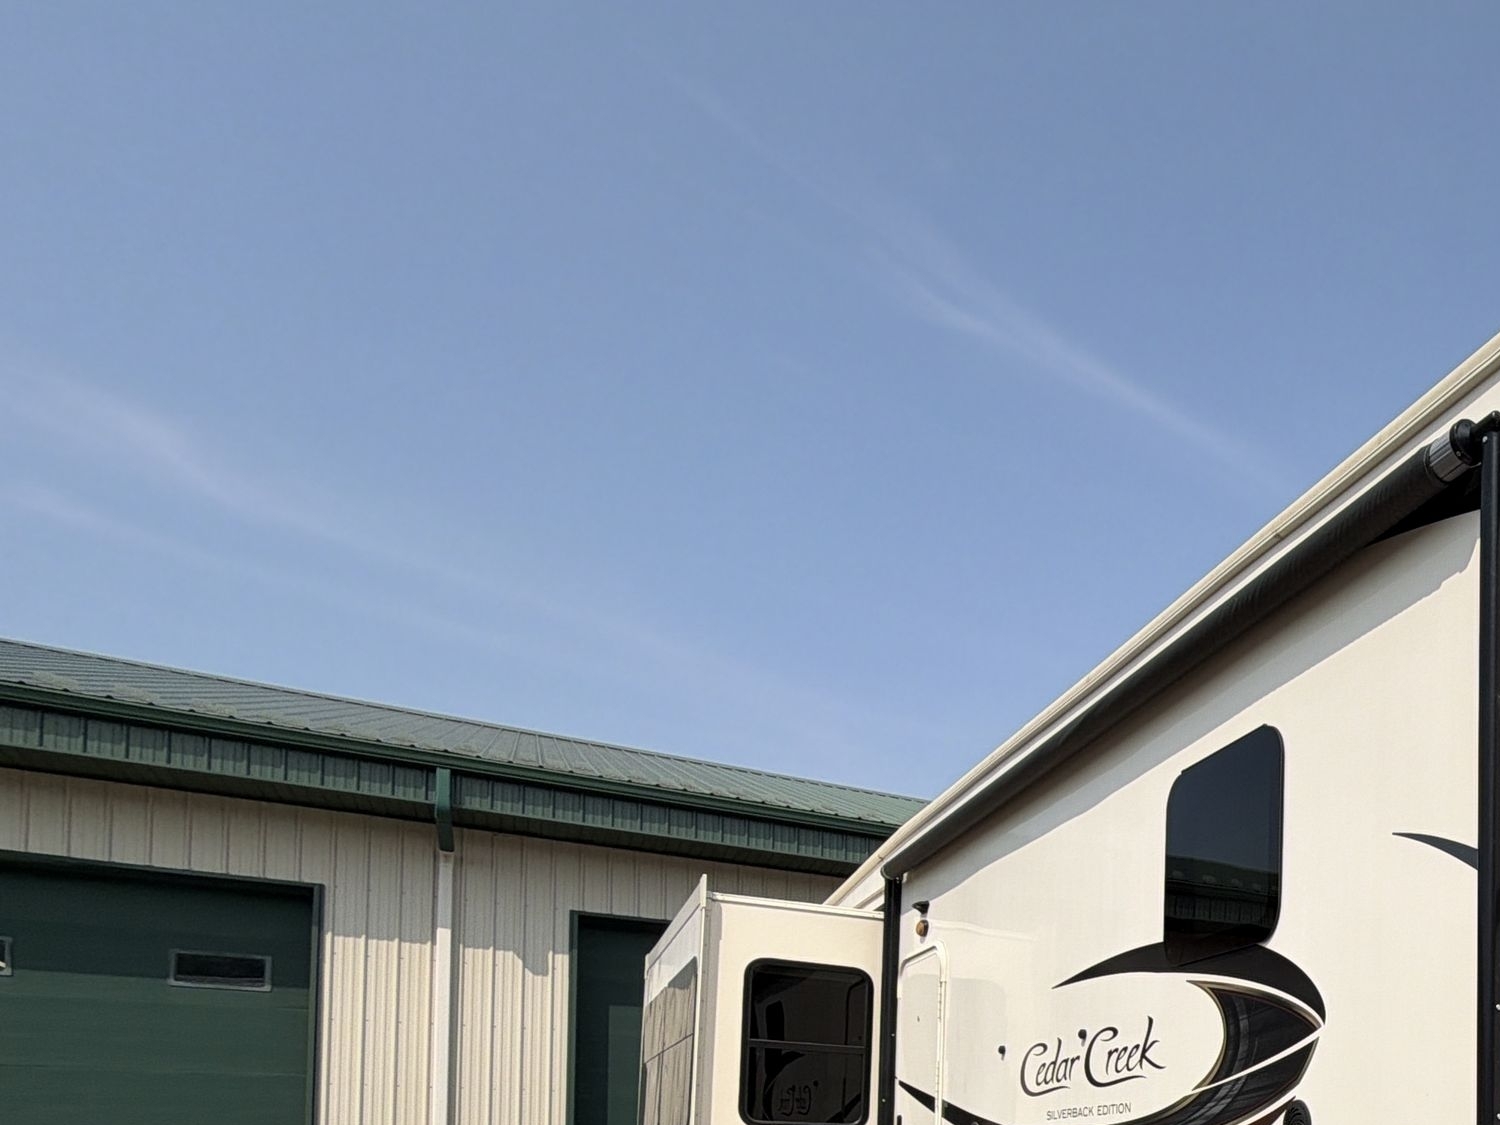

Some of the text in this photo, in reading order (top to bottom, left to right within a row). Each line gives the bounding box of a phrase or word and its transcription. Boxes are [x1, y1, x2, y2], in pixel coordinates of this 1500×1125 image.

[1020, 1015, 1167, 1097] Cedar Creek
[1046, 1102, 1132, 1121] SILVERBACK EDITION
